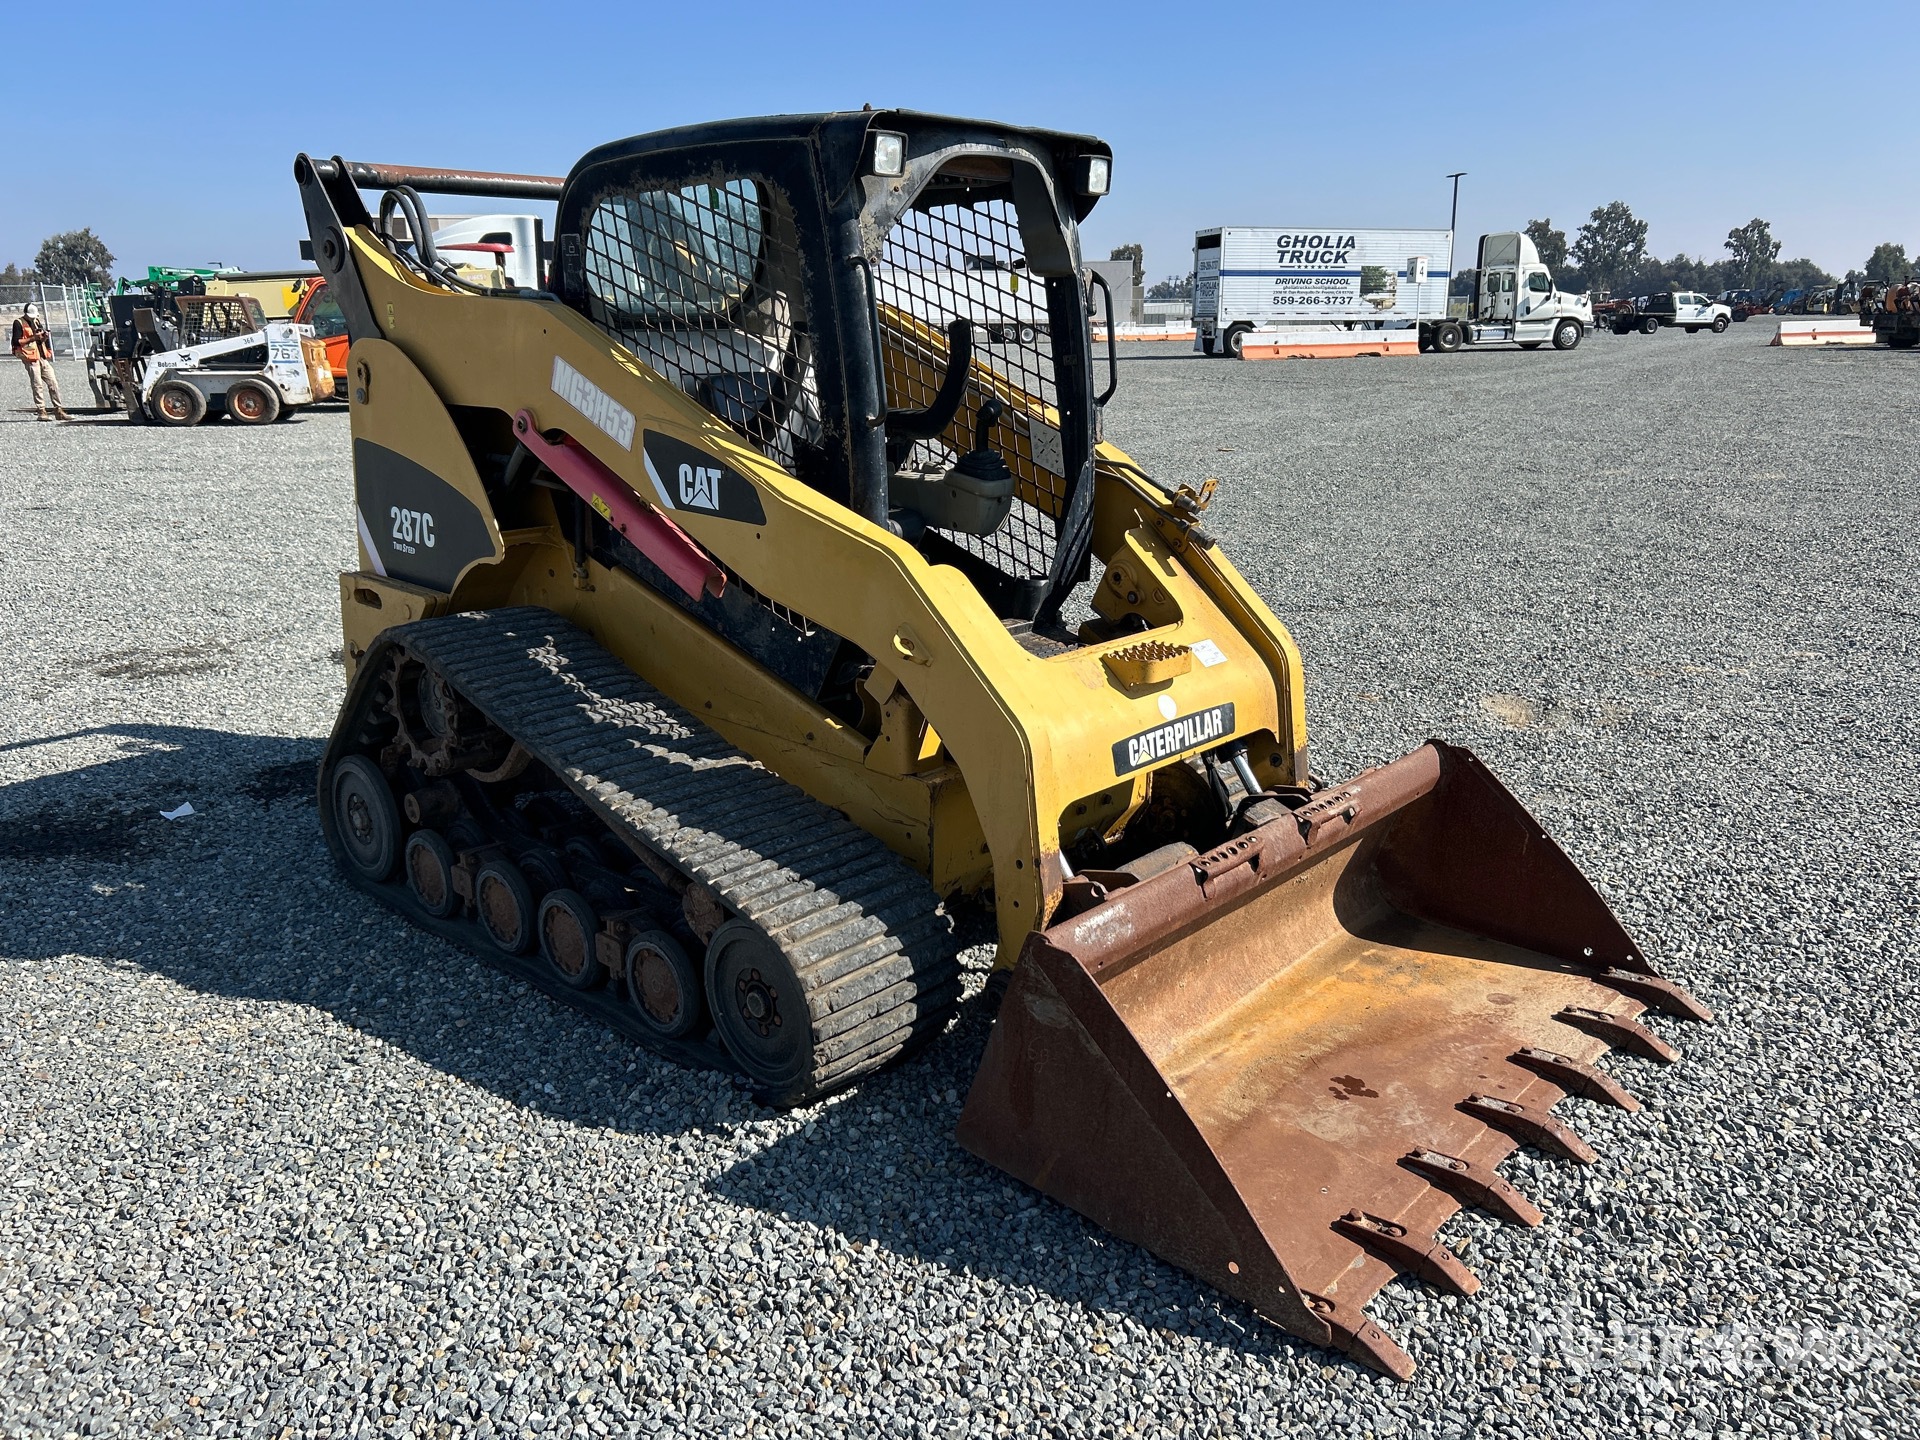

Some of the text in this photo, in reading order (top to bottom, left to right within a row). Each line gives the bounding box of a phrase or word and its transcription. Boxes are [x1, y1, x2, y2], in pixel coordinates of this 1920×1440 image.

[1276, 235, 1356, 249] GHOLIA
[1276, 250, 1350, 264] TRUCK
[1409, 266, 1414, 278] 4
[1419, 266, 1424, 277] 4
[1272, 296, 1354, 305] 559-266-3737
[678, 463, 722, 511] CAT
[390, 506, 435, 548] 287C
[1128, 708, 1223, 767] CATERPILLAR
